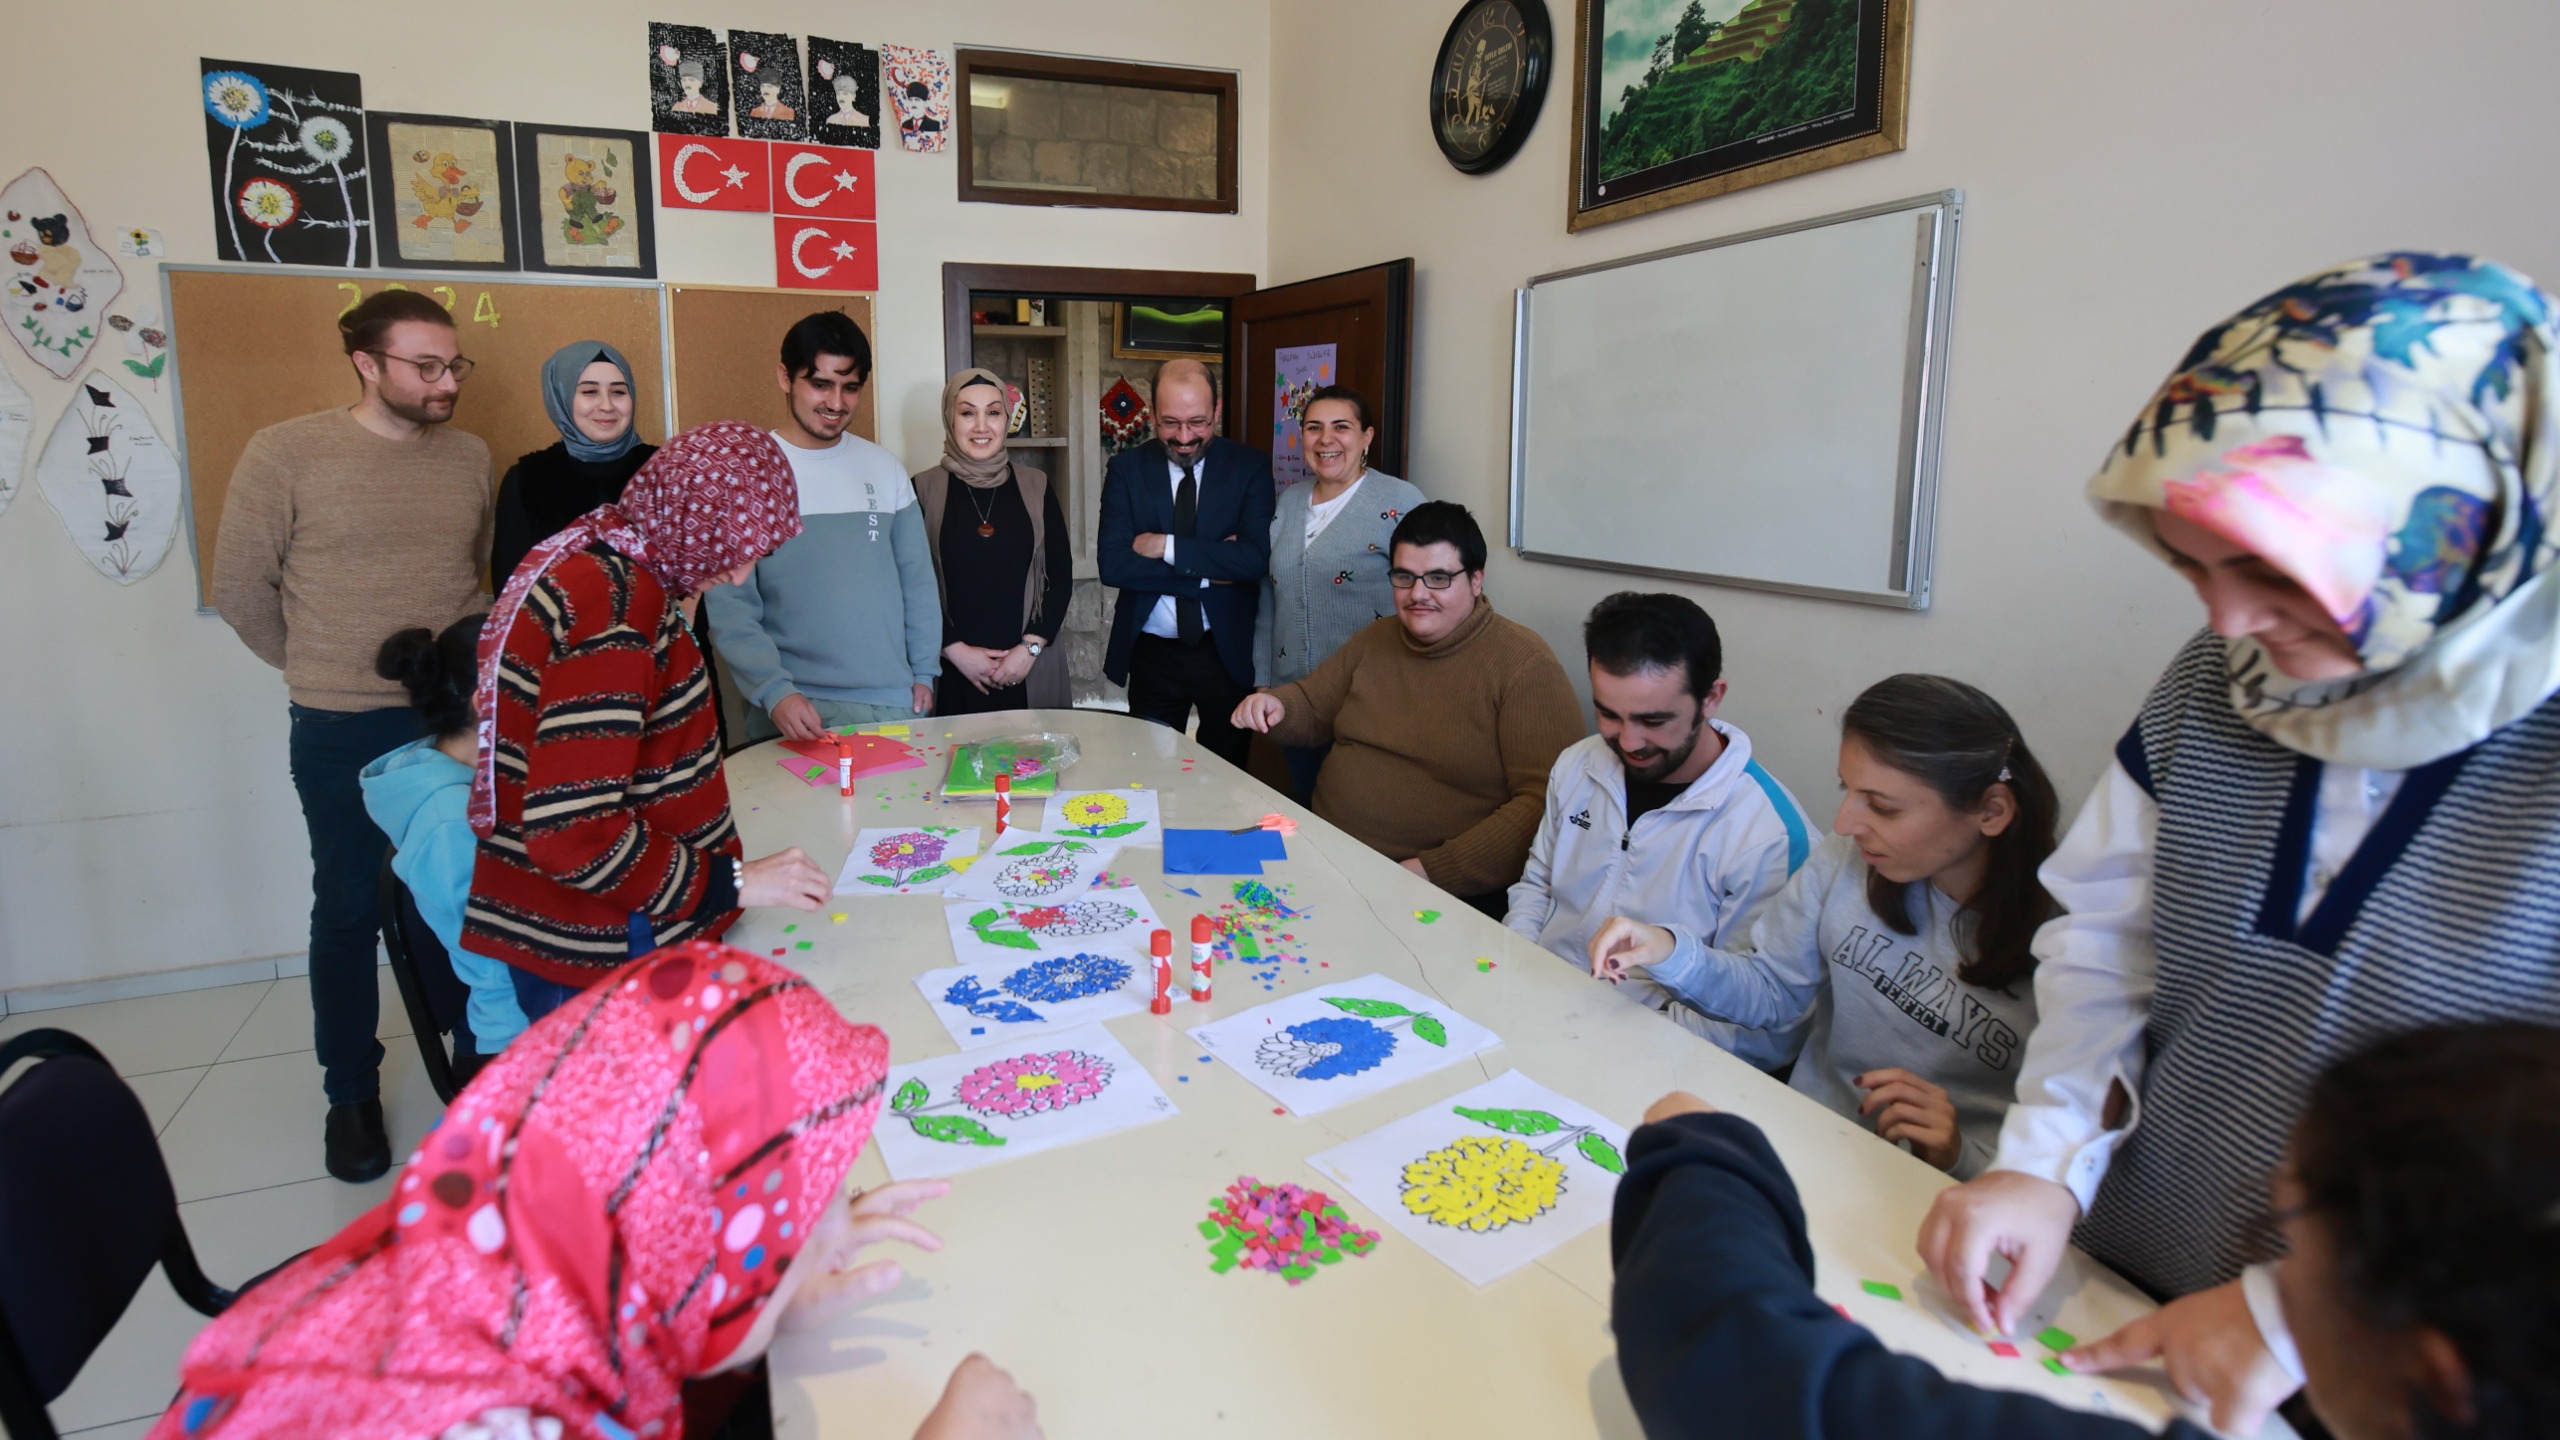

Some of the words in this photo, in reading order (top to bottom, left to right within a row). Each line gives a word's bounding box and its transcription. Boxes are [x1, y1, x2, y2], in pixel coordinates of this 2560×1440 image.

[337, 282, 501, 328] 224
[864, 482, 879, 541] BEST
[1832, 925, 2018, 1071] ALWAYS
[1877, 976, 1944, 1033] PERFECT
